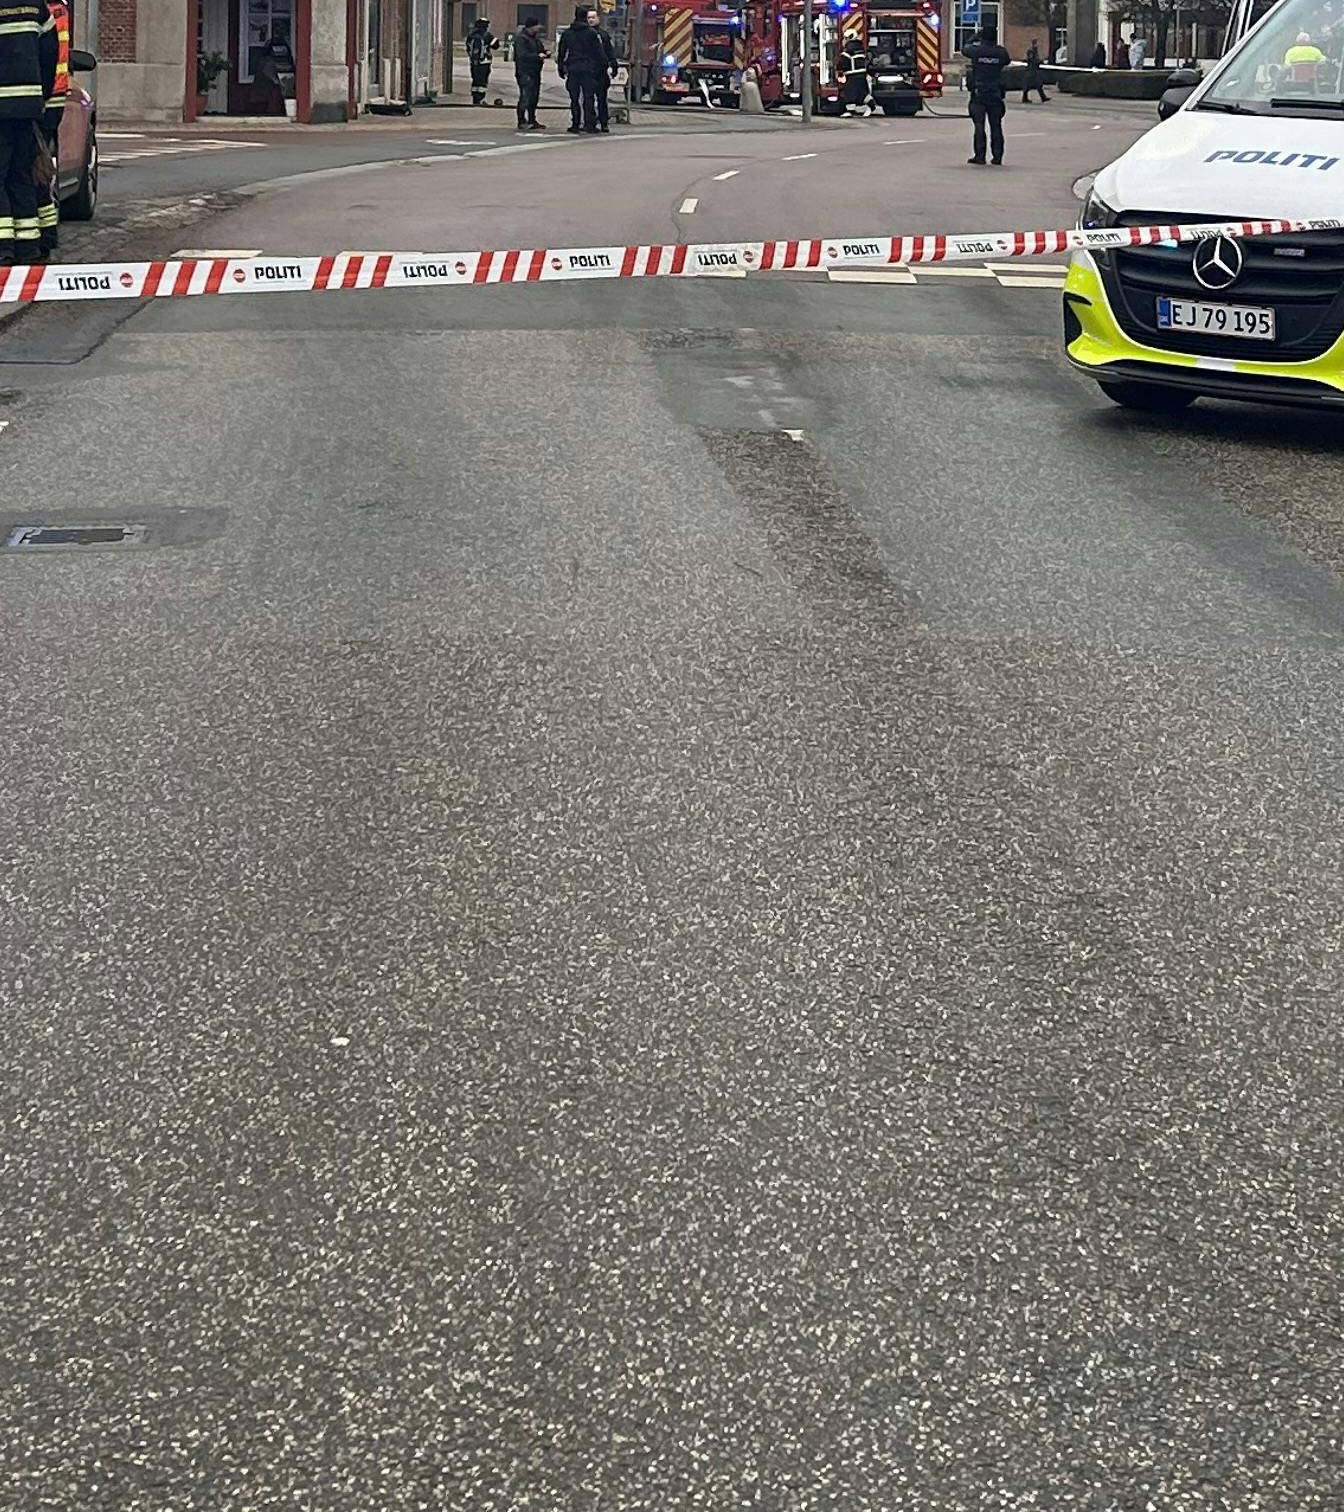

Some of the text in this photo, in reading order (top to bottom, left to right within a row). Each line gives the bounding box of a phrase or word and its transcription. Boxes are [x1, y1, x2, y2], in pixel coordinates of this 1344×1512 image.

[1203, 150, 1341, 171] POLITI
[843, 244, 880, 256] POLITI
[569, 254, 611, 268] POLITI
[697, 253, 738, 266] POLITI
[254, 265, 302, 280] POLITI
[403, 264, 448, 279] POLITI
[58, 276, 111, 291] POLITI
[1172, 304, 1270, 334] EJ 79 195
